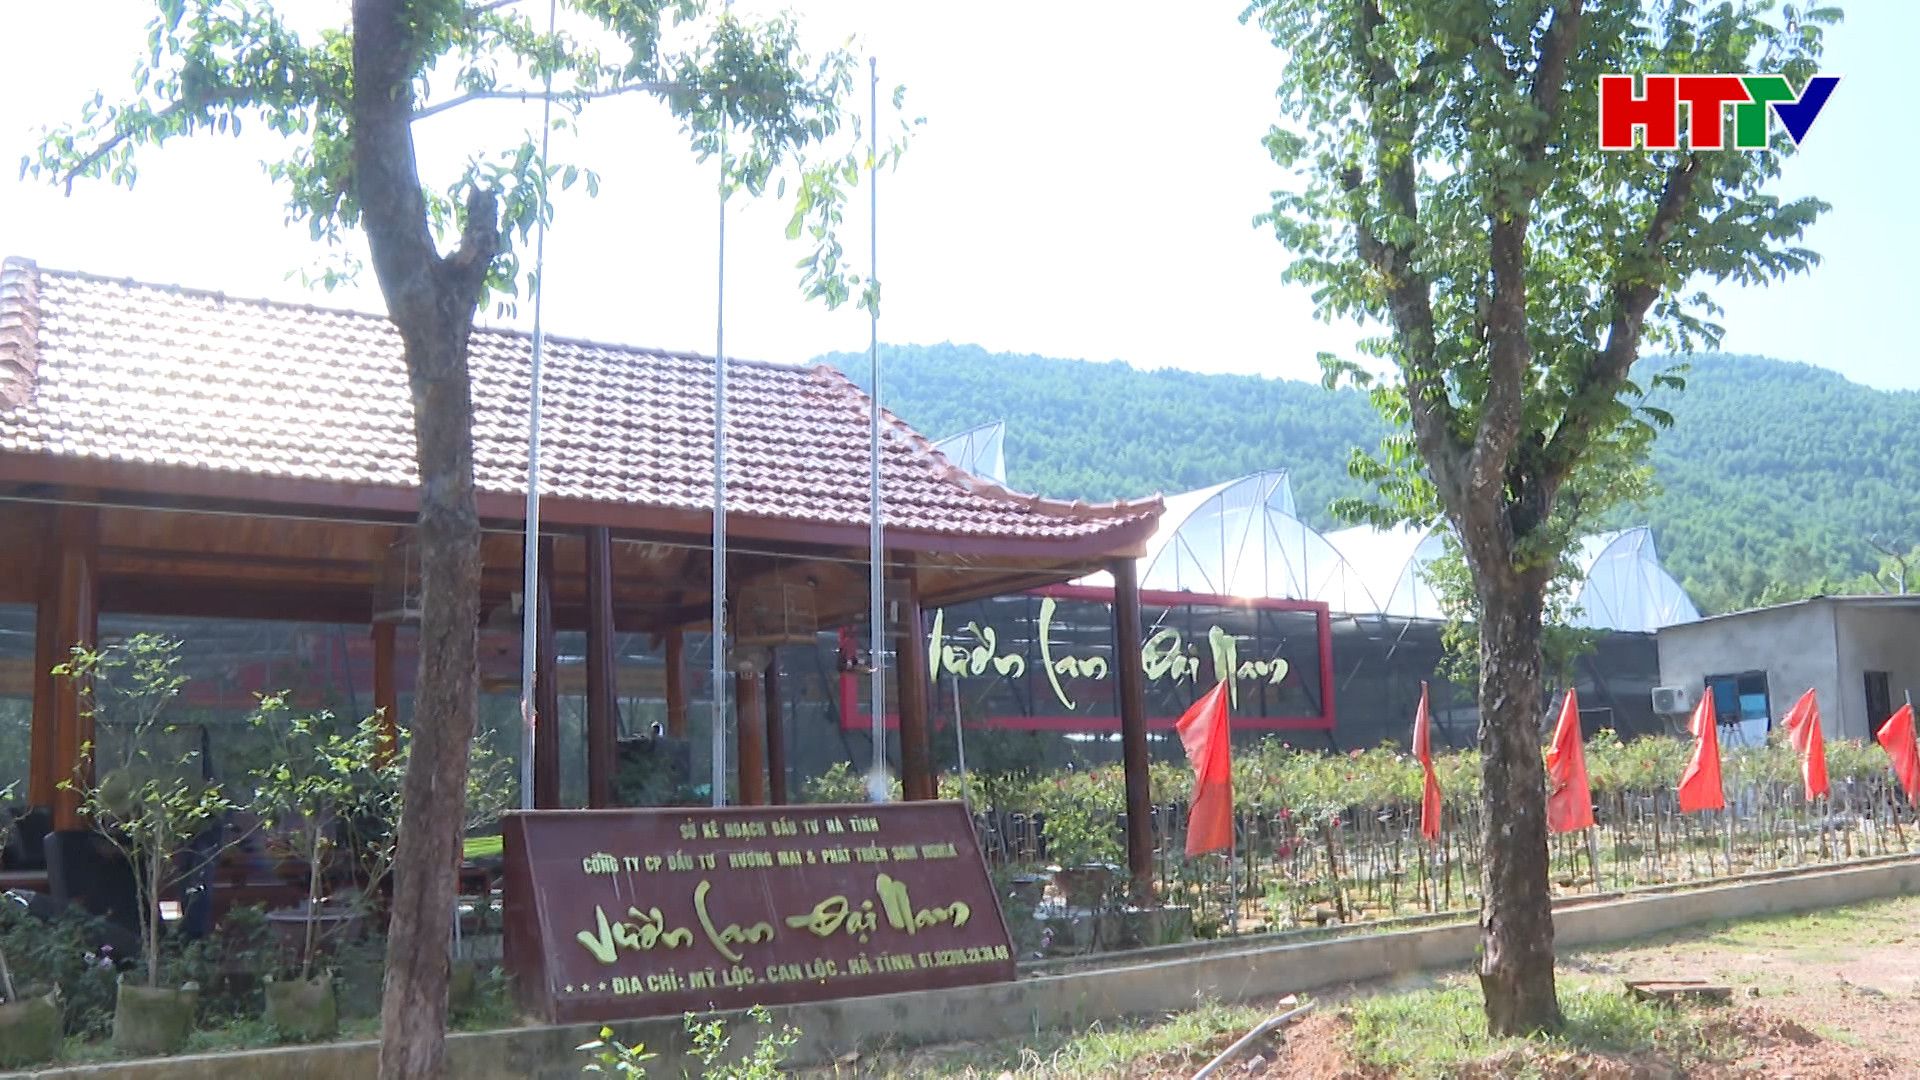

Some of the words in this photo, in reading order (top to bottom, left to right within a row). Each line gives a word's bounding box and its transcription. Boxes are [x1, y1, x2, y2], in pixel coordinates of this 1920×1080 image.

[623, 856, 639, 872] TY
[644, 855, 662, 872] CP
[766, 963, 803, 982] CAN
